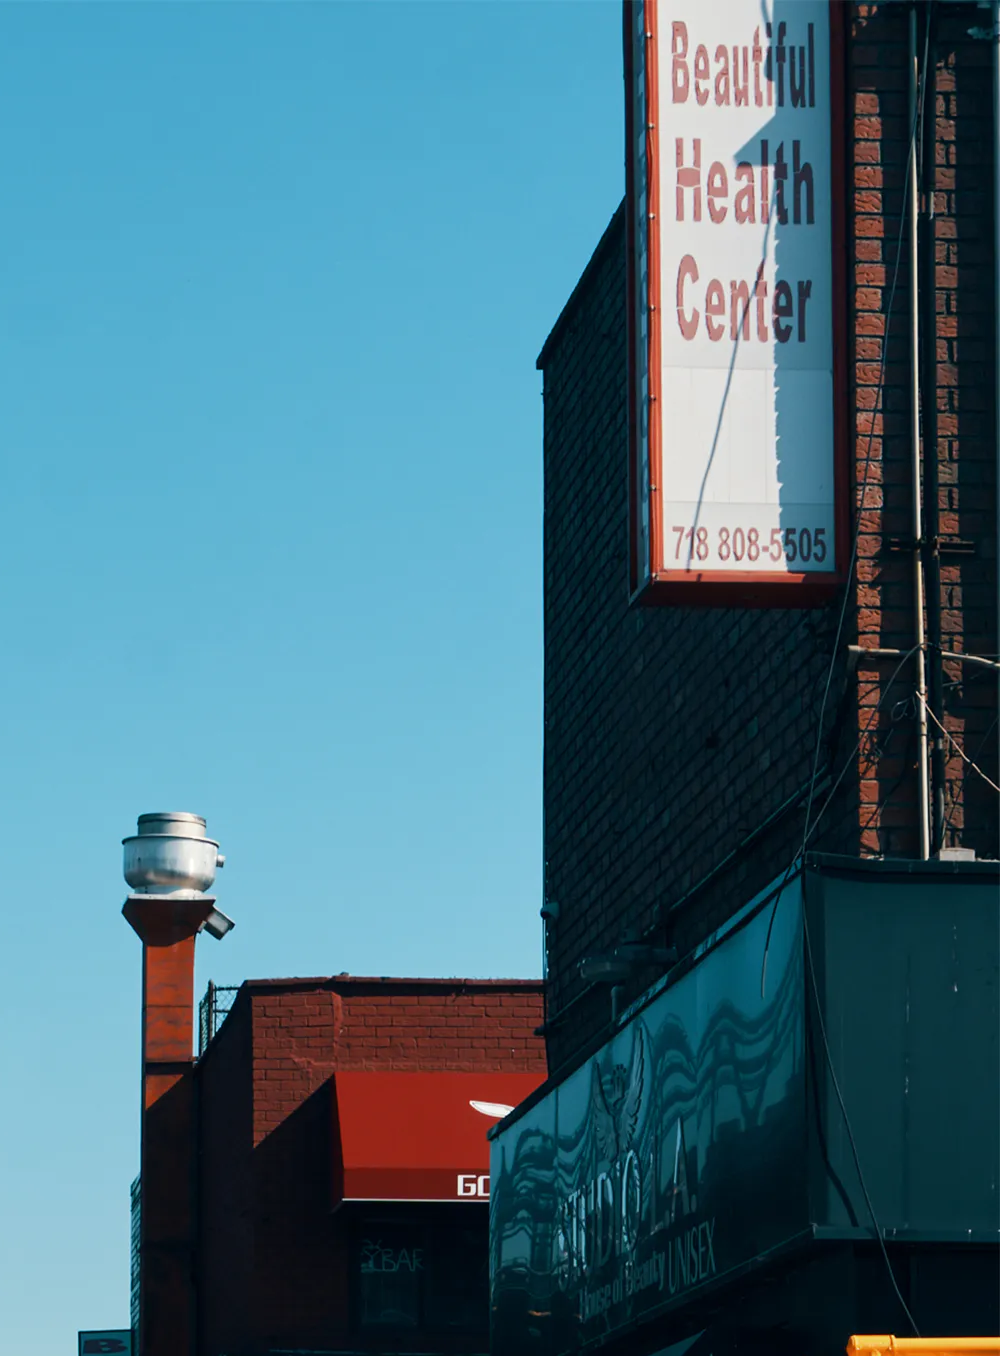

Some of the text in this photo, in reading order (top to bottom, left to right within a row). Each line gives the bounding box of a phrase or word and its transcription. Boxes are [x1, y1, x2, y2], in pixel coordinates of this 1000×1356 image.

[671, 20, 816, 108] Beautiful
[675, 137, 815, 226] Health
[675, 254, 812, 344] Center
[671, 526, 827, 564] 718 808-5505
[668, 1216, 717, 1295] UNISEX
